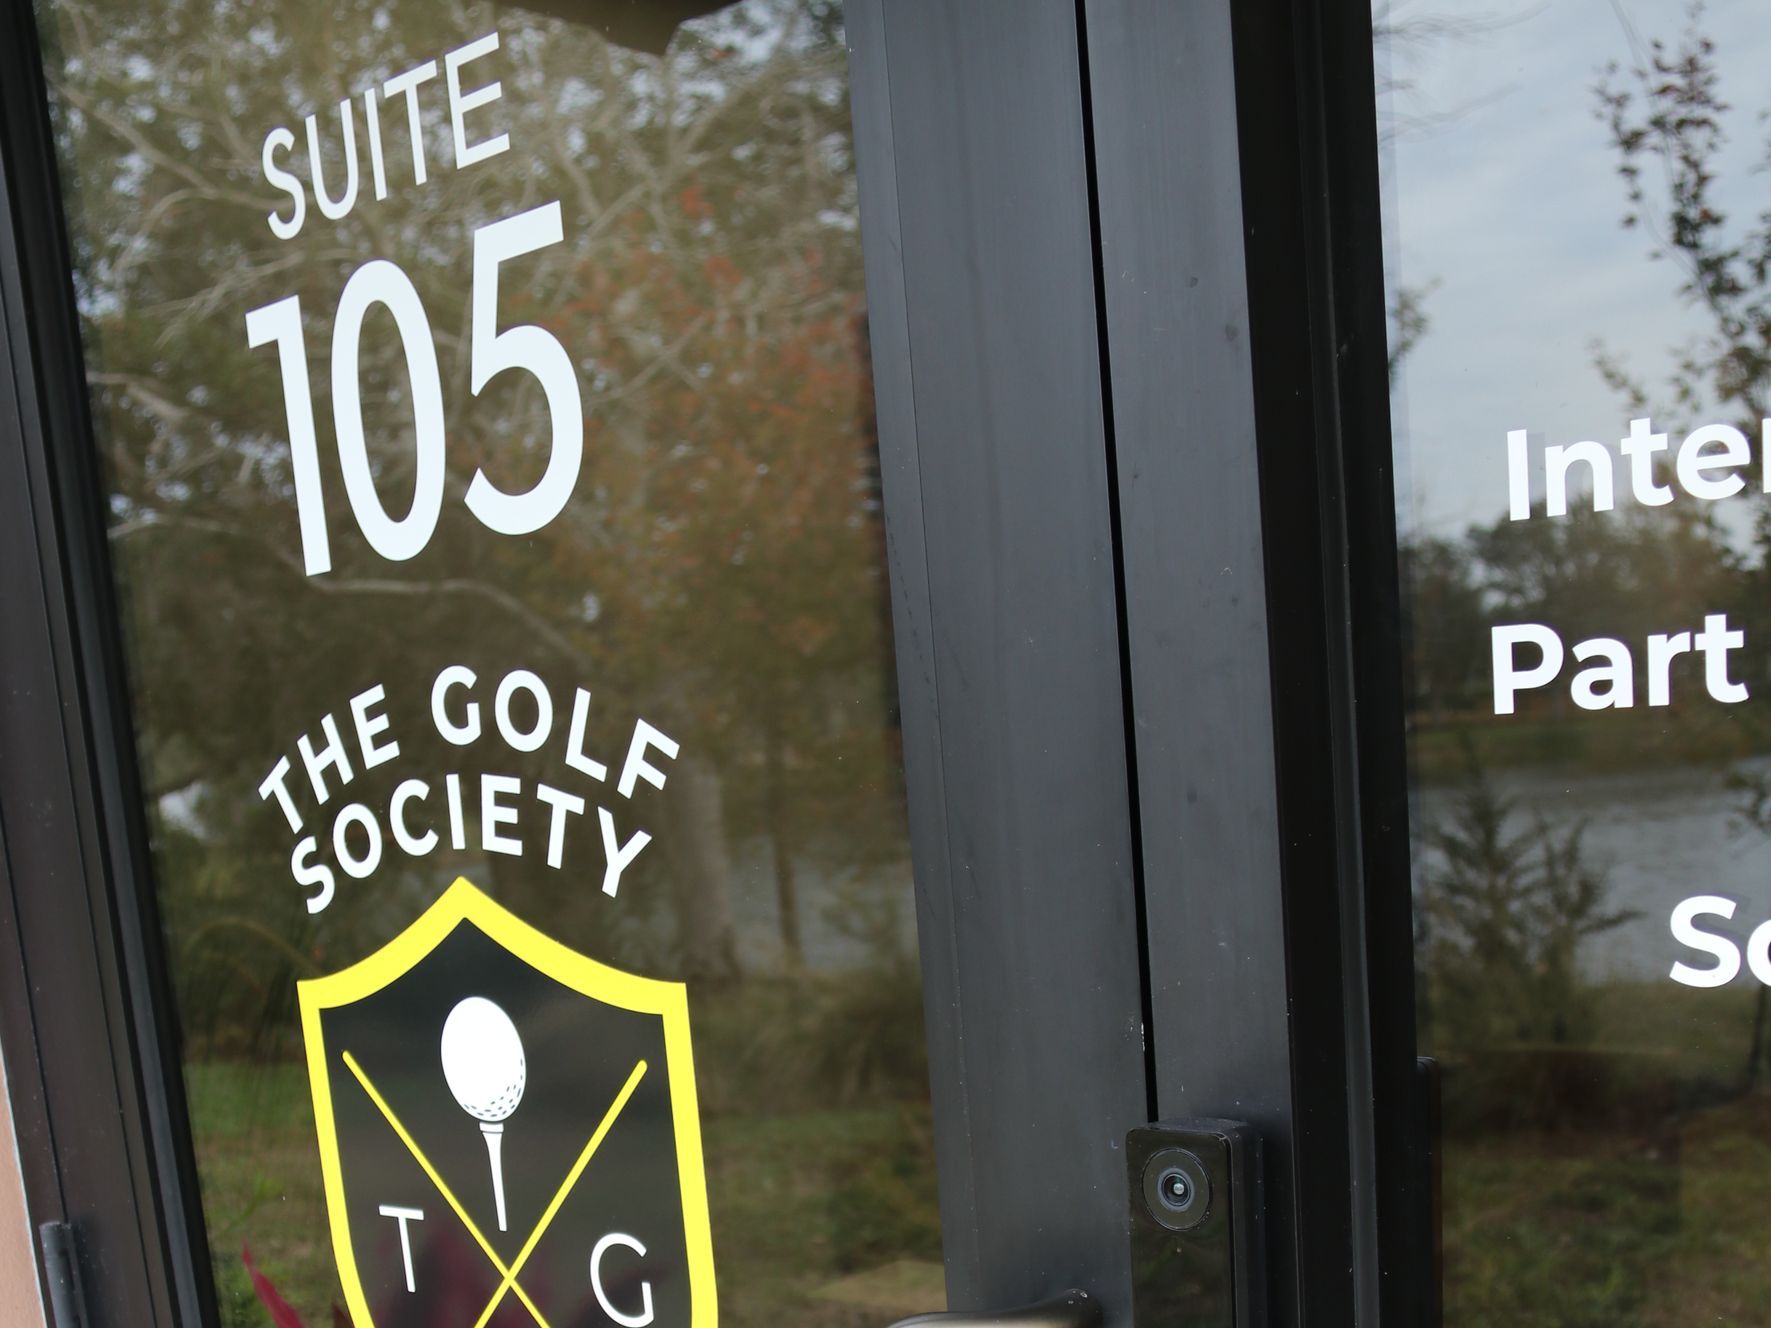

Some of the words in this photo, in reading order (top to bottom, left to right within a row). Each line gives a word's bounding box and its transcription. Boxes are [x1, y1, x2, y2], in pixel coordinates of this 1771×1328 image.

[262, 32, 510, 240] SUITE
[245, 200, 584, 576] 105
[1507, 417, 1771, 521] Inte
[1491, 614, 1749, 715] Part
[258, 683, 400, 834] THE
[431, 665, 680, 799] GOLF
[291, 773, 652, 914] SOCIETY
[378, 1205, 424, 1293] T
[590, 1232, 655, 1328] G
